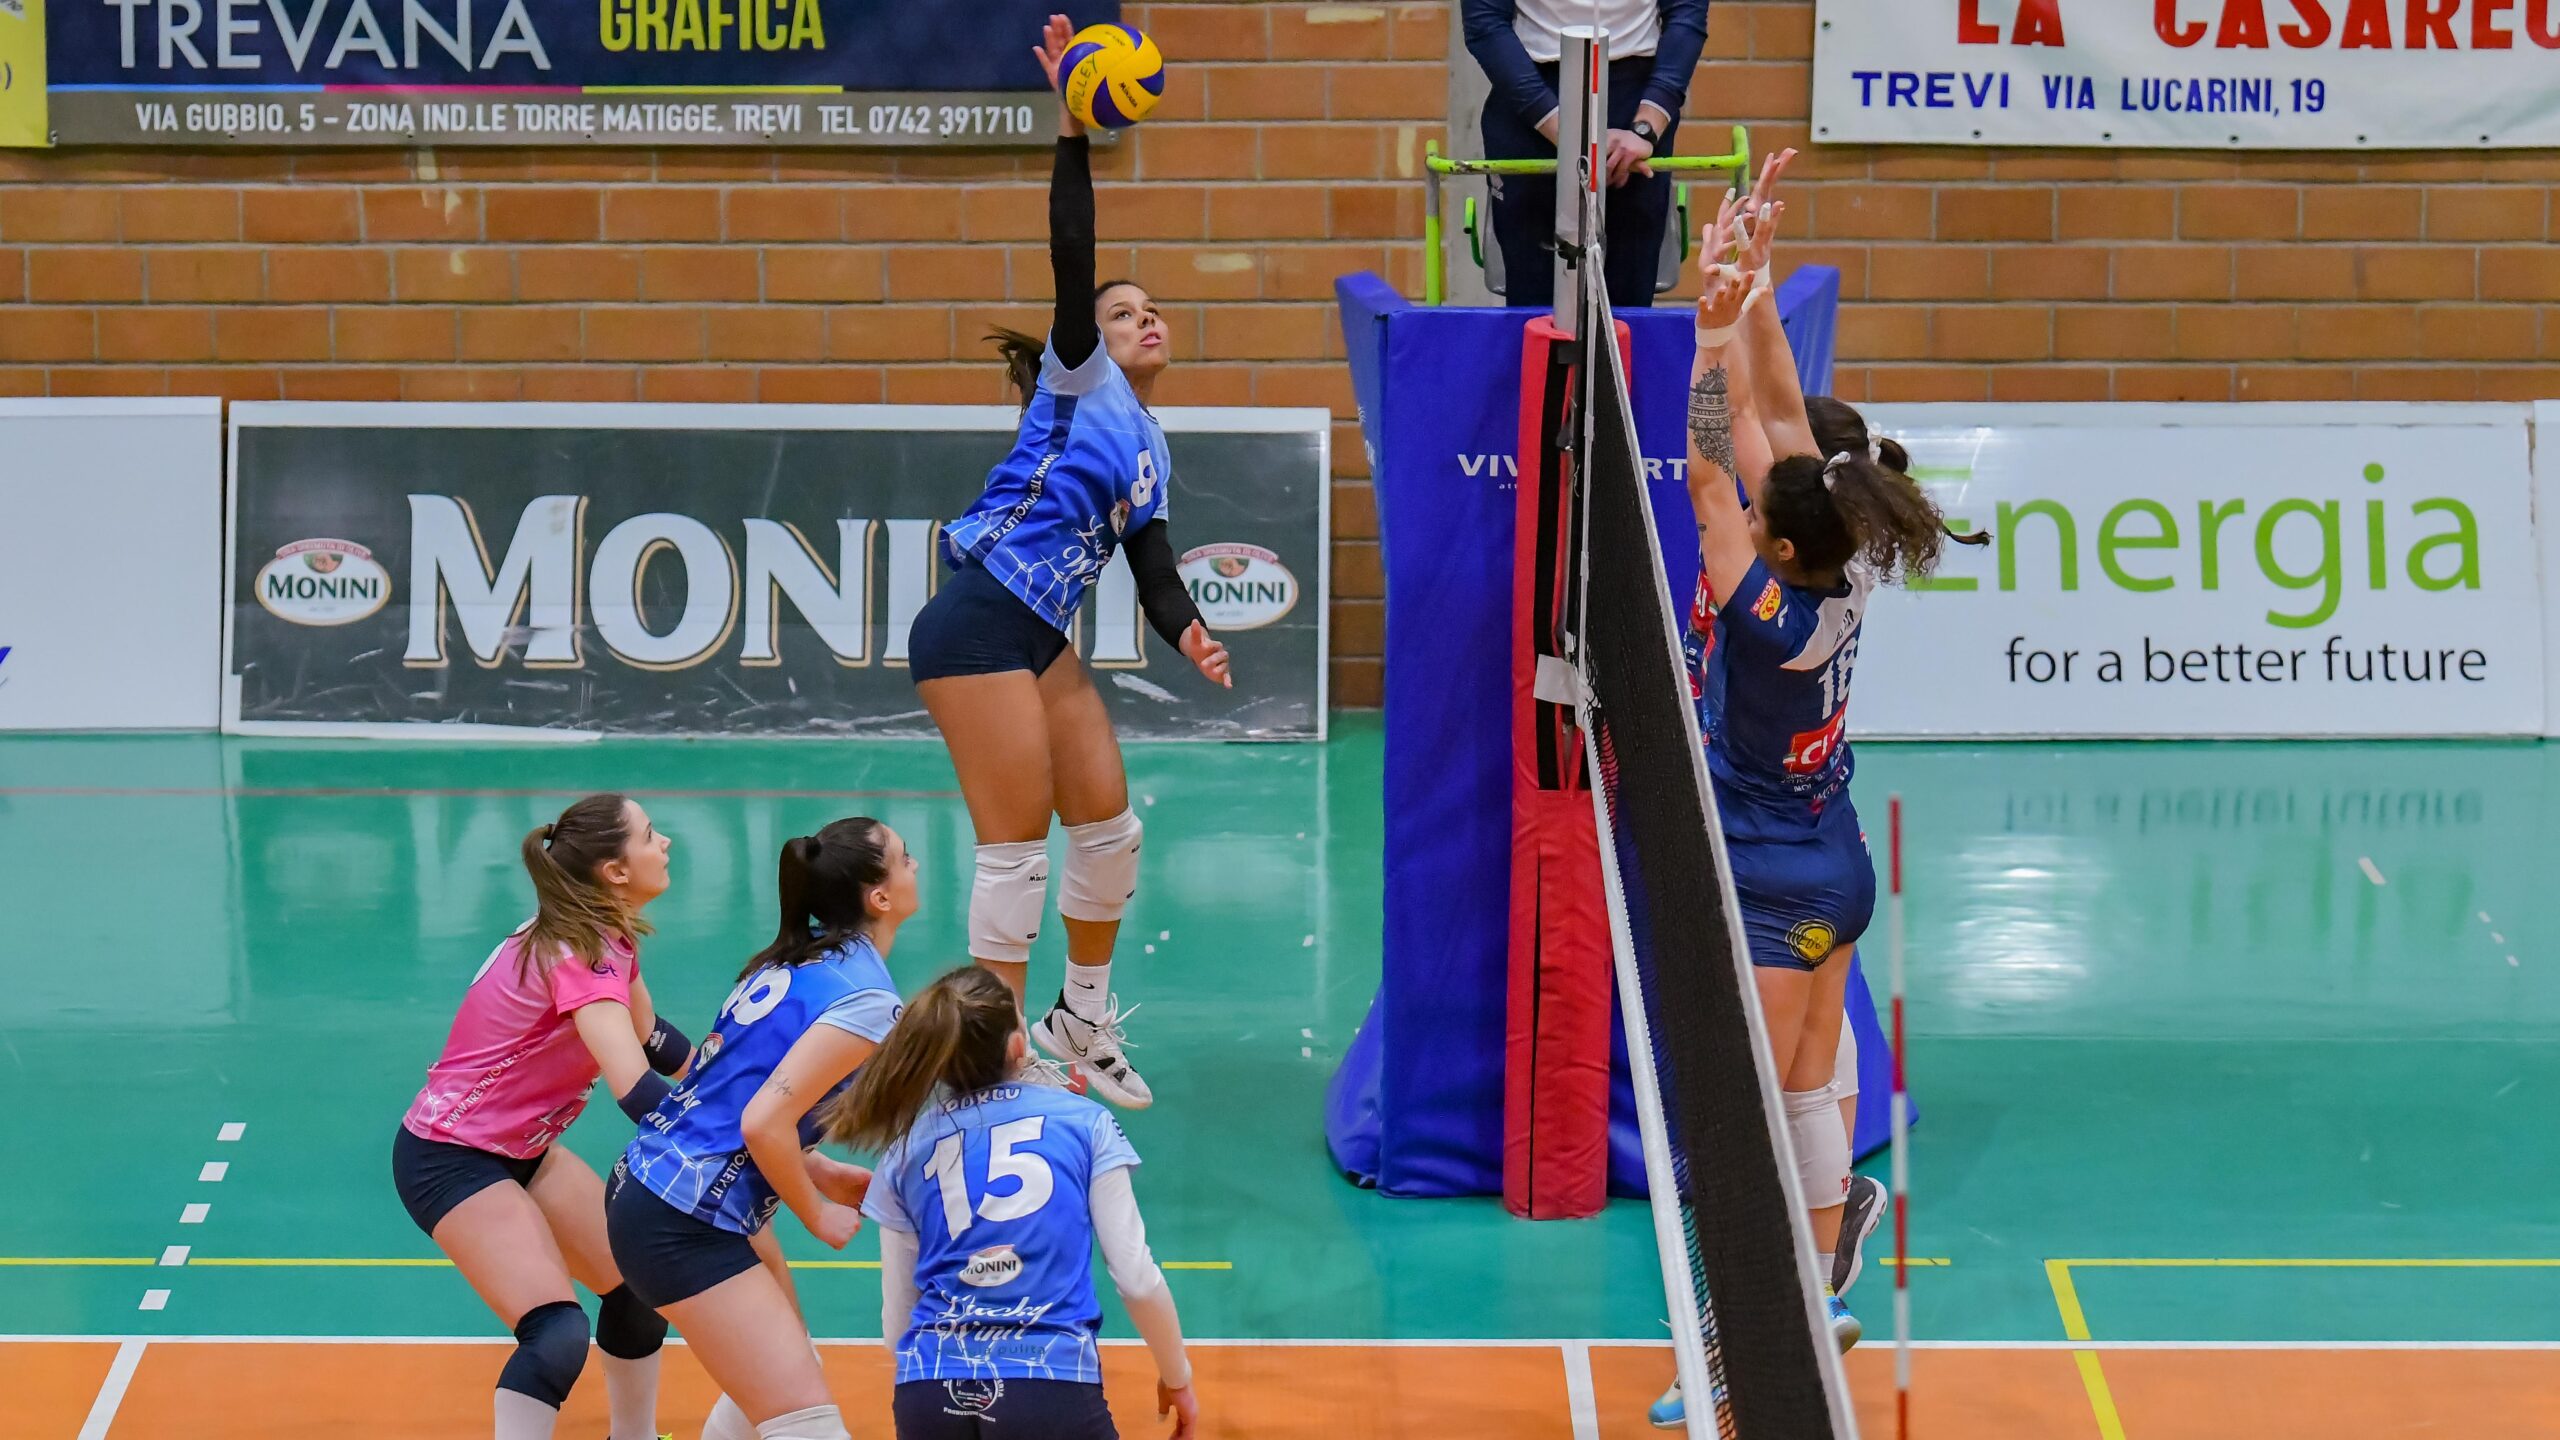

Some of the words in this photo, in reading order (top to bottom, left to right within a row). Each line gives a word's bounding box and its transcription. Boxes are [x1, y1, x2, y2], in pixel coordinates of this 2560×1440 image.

[104, 0, 551, 73] TREVANA
[599, 0, 826, 51] GRAFICA
[1957, 0, 2065, 46] LA
[1852, 72, 2009, 109] TREVI
[2043, 76, 2096, 110] VIA
[2121, 77, 2280, 117] LUCARINI,
[2292, 79, 2326, 112] 19
[136, 104, 178, 131] VIA
[187, 104, 291, 134] GUBBIO,
[300, 104, 315, 131] 5
[347, 104, 415, 131] ZONA
[424, 104, 506, 131] IND.LE
[514, 104, 595, 131] TORRE
[732, 105, 800, 132] TREVI
[818, 106, 861, 133] TEL
[869, 106, 931, 133] 0742
[939, 106, 1033, 134] 391710
[268, 574, 378, 599] MONINI
[403, 494, 1147, 668] MONII
[2005, 637, 2079, 683] for
[2097, 650, 2123, 683] a
[2144, 637, 2308, 683] better
[2323, 636, 2487, 683] future
[922, 1114, 1055, 1241] 15
